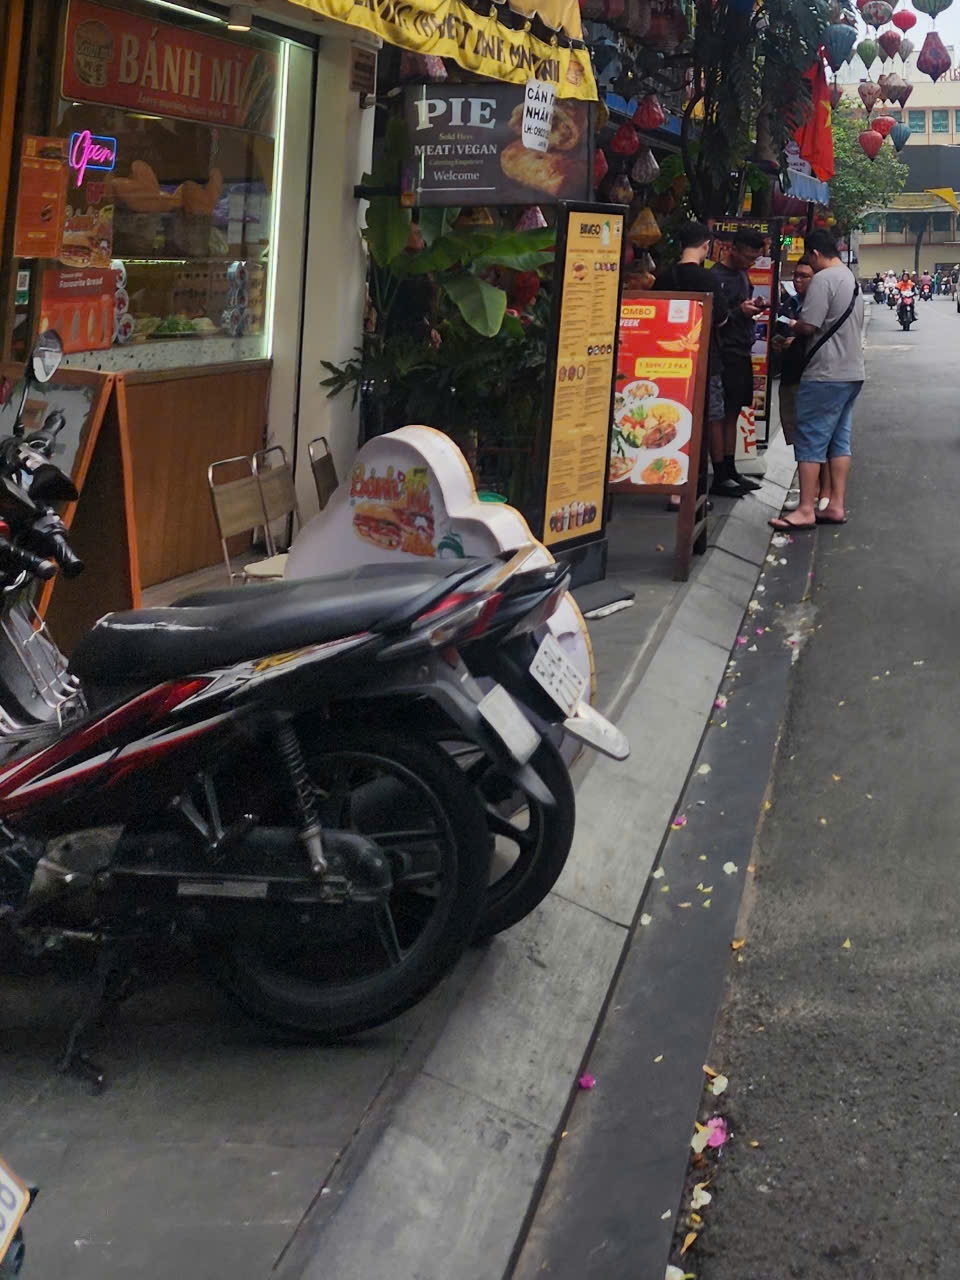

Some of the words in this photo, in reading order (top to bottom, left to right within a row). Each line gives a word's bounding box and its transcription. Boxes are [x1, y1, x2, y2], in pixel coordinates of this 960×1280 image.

[119, 28, 201, 98] BÁNH
[413, 98, 497, 131] PIE
[414, 144, 451, 156] MEAT
[456, 144, 497, 155] VEGAN
[433, 170, 480, 181] Welcome
[714, 222, 737, 232] THE
[621, 307, 652, 316] OMBO
